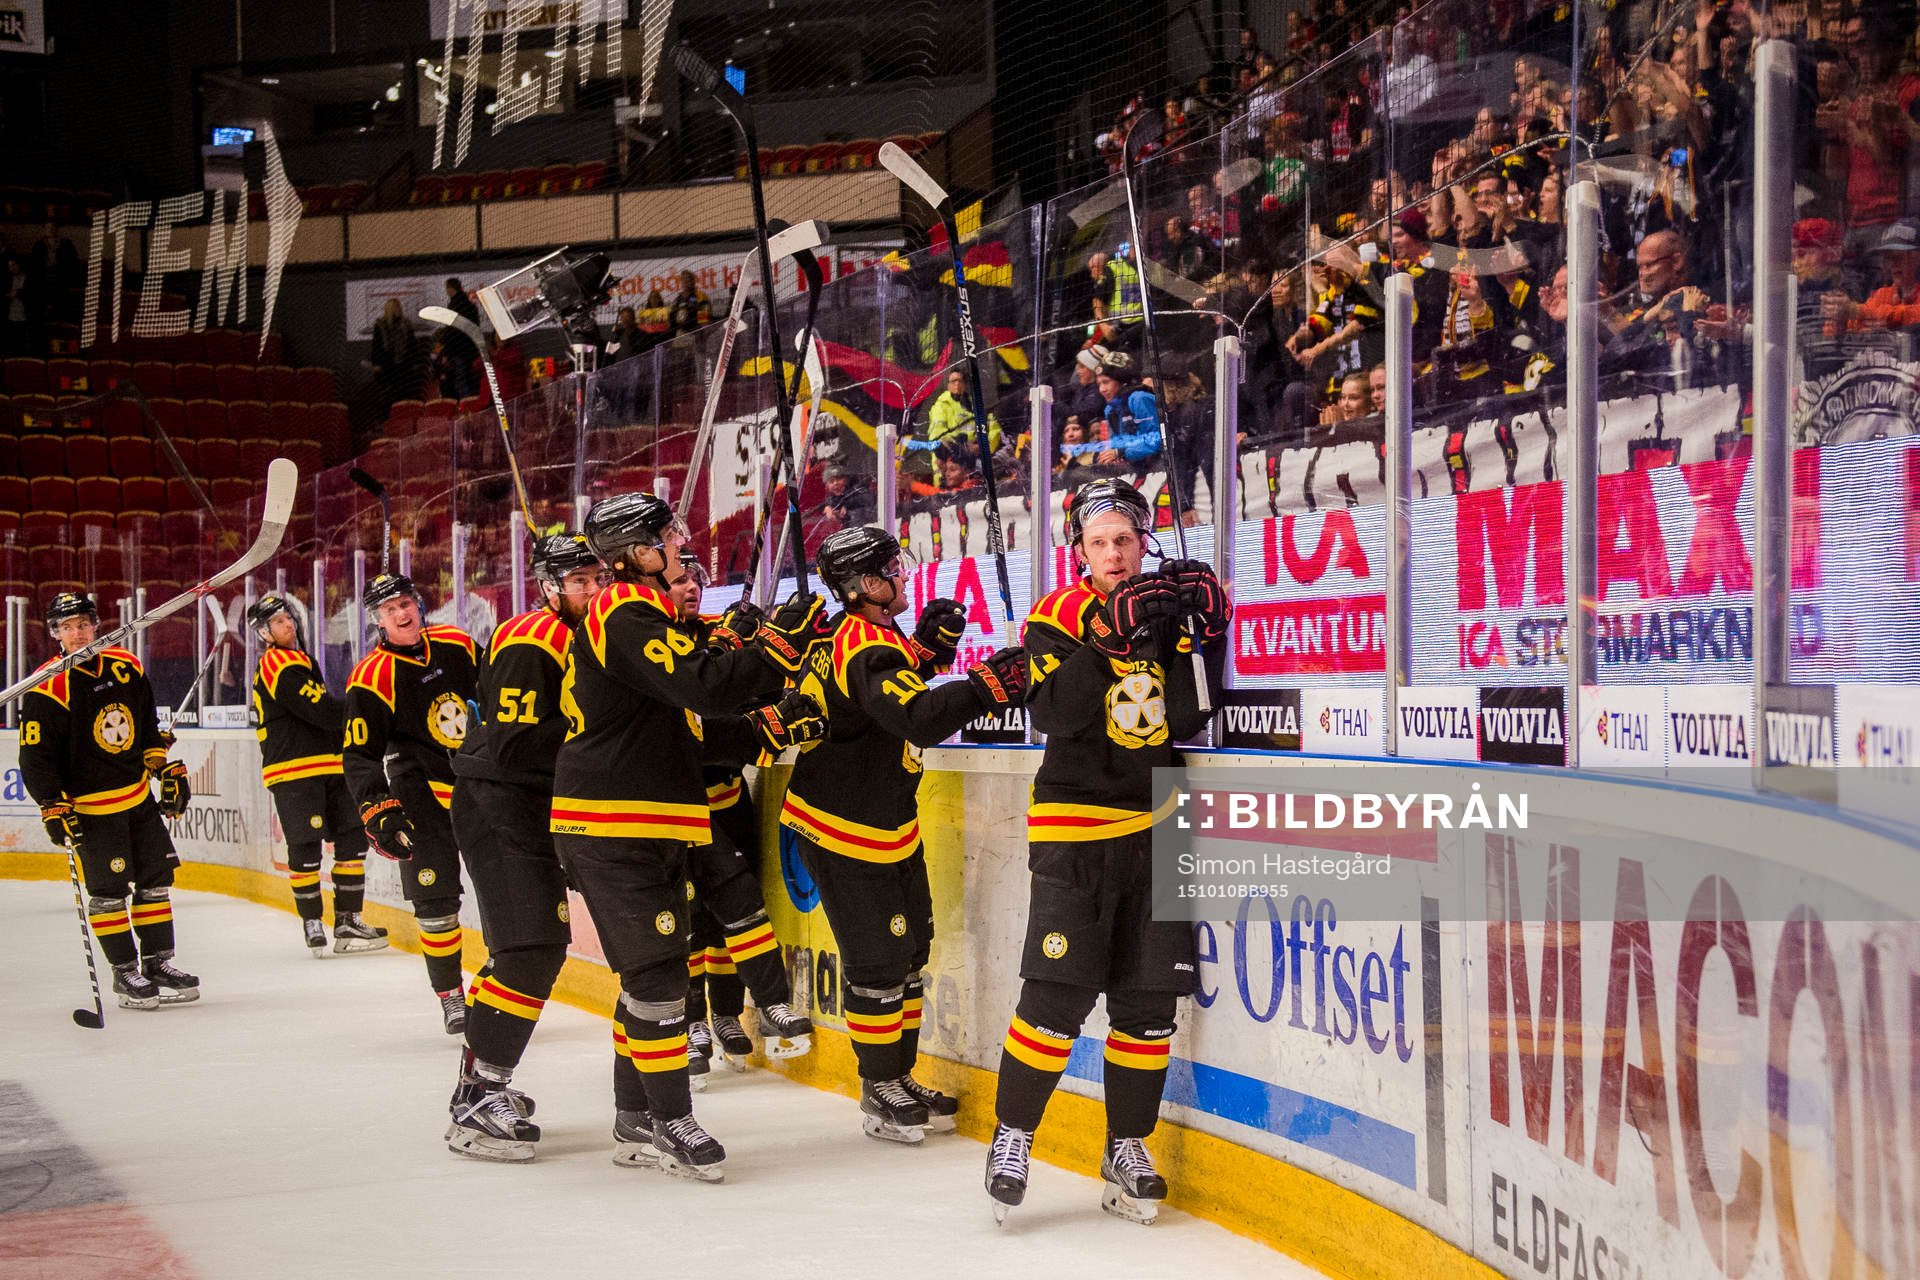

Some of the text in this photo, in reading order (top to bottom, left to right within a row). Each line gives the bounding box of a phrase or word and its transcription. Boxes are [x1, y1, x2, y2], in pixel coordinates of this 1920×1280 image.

[958, 286, 977, 358] NEXUS
[1263, 508, 1370, 585] ICA
[111, 661, 131, 684] C
[1129, 660, 1148, 673] 12
[496, 687, 540, 725] 51
[881, 669, 929, 706] 10
[1224, 705, 1299, 735] VOLVIA
[1332, 708, 1368, 737] THAI
[1400, 706, 1474, 740] VOLVIA
[1482, 708, 1564, 745] VOLVIA
[1610, 713, 1649, 751] THAI
[1671, 713, 1749, 760] VOLVIA
[1766, 711, 1835, 769] VOLVIA
[787, 820, 821, 843] BAUER
[1233, 887, 1414, 1064] Offset
[1036, 1025, 1070, 1040] BAUER
[1144, 1027, 1173, 1036] BAUER
[1491, 1171, 1643, 1280] ELDFAS
